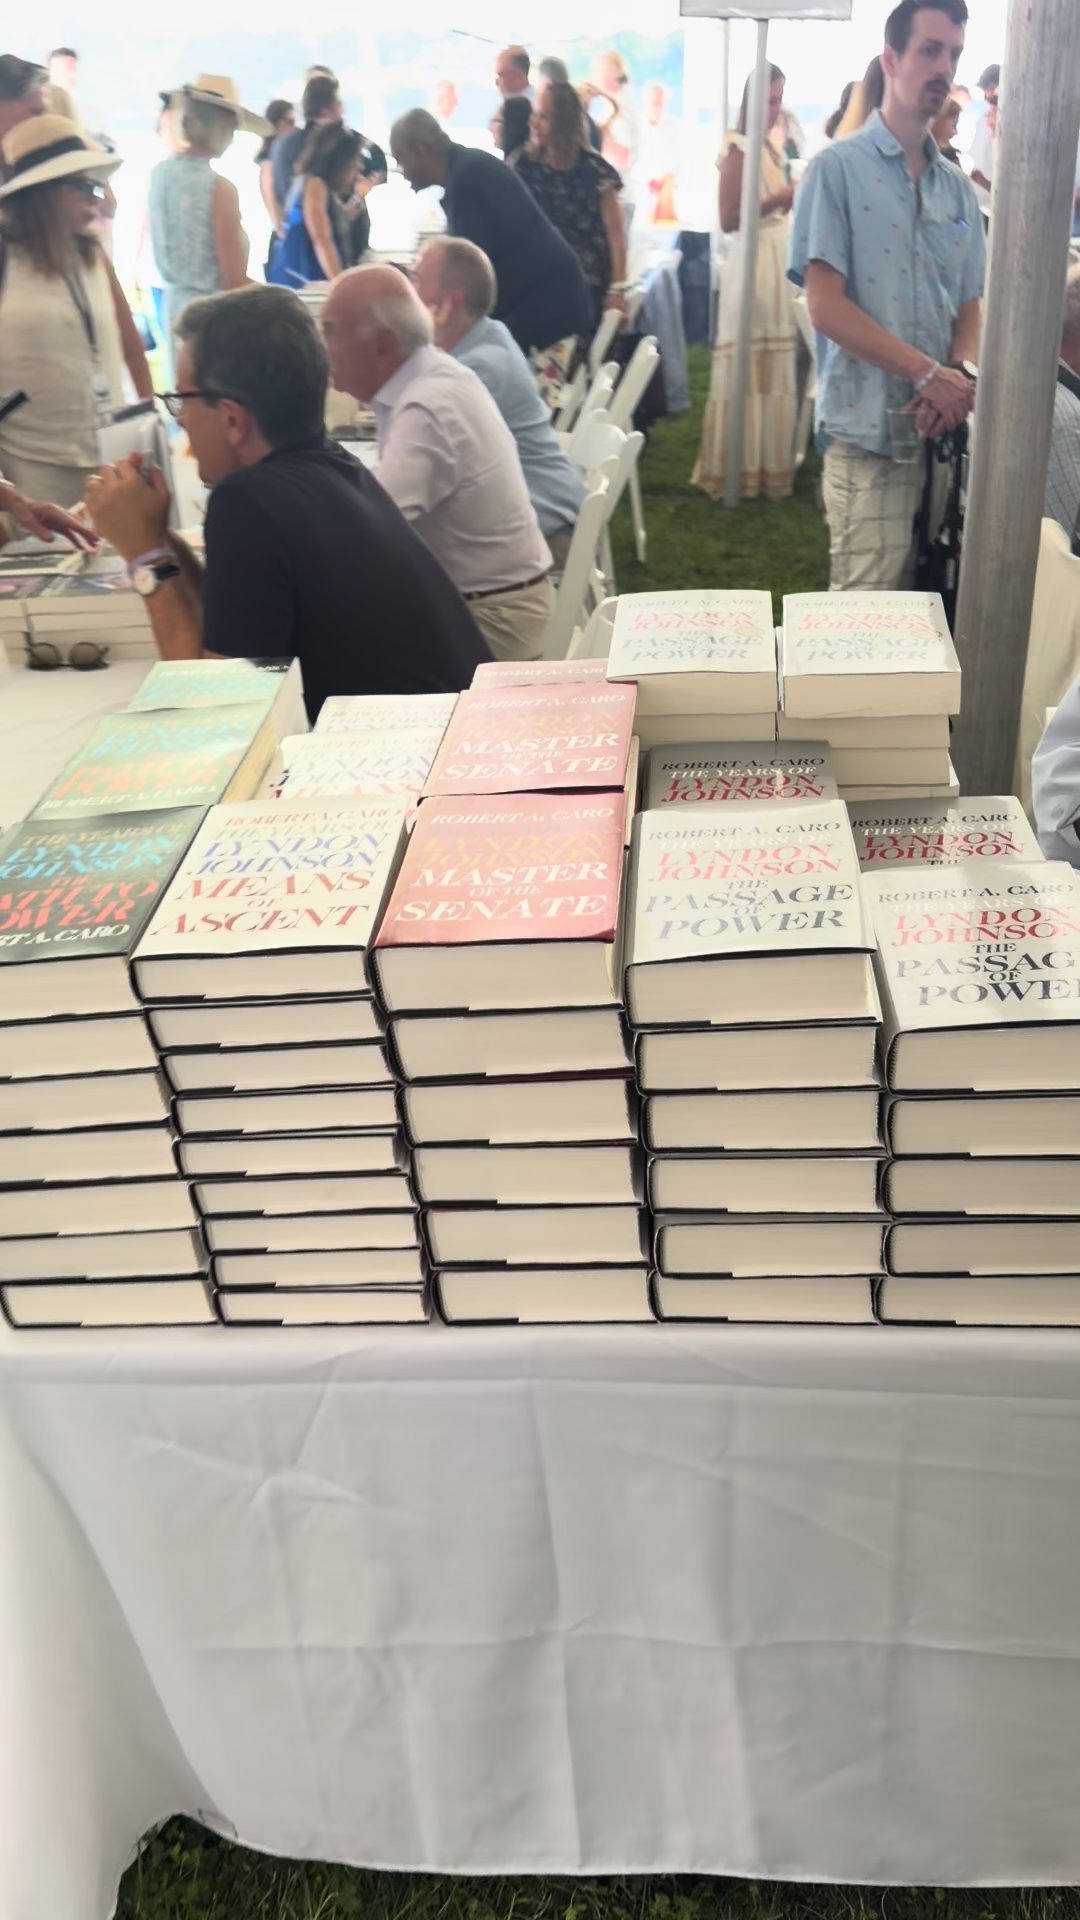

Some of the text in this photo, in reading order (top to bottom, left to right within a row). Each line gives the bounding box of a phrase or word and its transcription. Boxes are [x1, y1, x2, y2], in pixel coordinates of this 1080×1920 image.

[468, 695, 626, 709] ROBERT A. CARO
[453, 733, 620, 756] MASTER
[438, 755, 619, 781] SENATE
[661, 757, 826, 771] ROBERT A. CARO
[669, 766, 817, 779] THE YEARS OF
[667, 774, 821, 791] LYNDON
[660, 785, 828, 802] JOHNSON
[225, 811, 315, 826] ROBERT
[336, 808, 403, 822] CARO
[430, 807, 615, 825] ROBERT A. CARO
[852, 815, 931, 828] ROBERT
[961, 814, 1019, 824] CARO
[649, 822, 841, 841] ROBERT A. CARO
[861, 827, 903, 837] THE
[909, 824, 976, 835] YEARS
[200, 833, 391, 858] LYNDON
[423, 830, 607, 853] LYNDON
[657, 833, 833, 850] THE YEARS OF
[864, 831, 1015, 850] LYNDON
[417, 847, 604, 868] JOHNSON
[656, 843, 835, 867] LYNDON
[859, 842, 1026, 861] JOHNSON
[0, 852, 167, 880] OHNSON
[187, 851, 383, 876] JOHNSON
[648, 857, 845, 883] JOHNSON
[409, 861, 609, 888] MASTER
[175, 870, 377, 900] MEANS
[469, 885, 544, 897] OF THE
[725, 879, 769, 890] THE
[879, 884, 1075, 903] ROBERT A. CARO
[247, 898, 280, 908] OF
[643, 884, 854, 913] PASSAGE
[889, 902, 937, 914] THE
[944, 898, 1025, 911] YEARS
[0, 900, 136, 930] OWER
[394, 894, 609, 923] SENATE
[734, 903, 768, 915] OF
[149, 905, 370, 936] ASCENT
[655, 909, 848, 941] POWER
[895, 906, 1074, 931] LYNDON
[53, 924, 131, 941] CARO
[890, 921, 1080, 948] JOHNSON
[971, 942, 1017, 954] THE
[894, 950, 1078, 978] PASSAG
[988, 971, 1022, 982] OF
